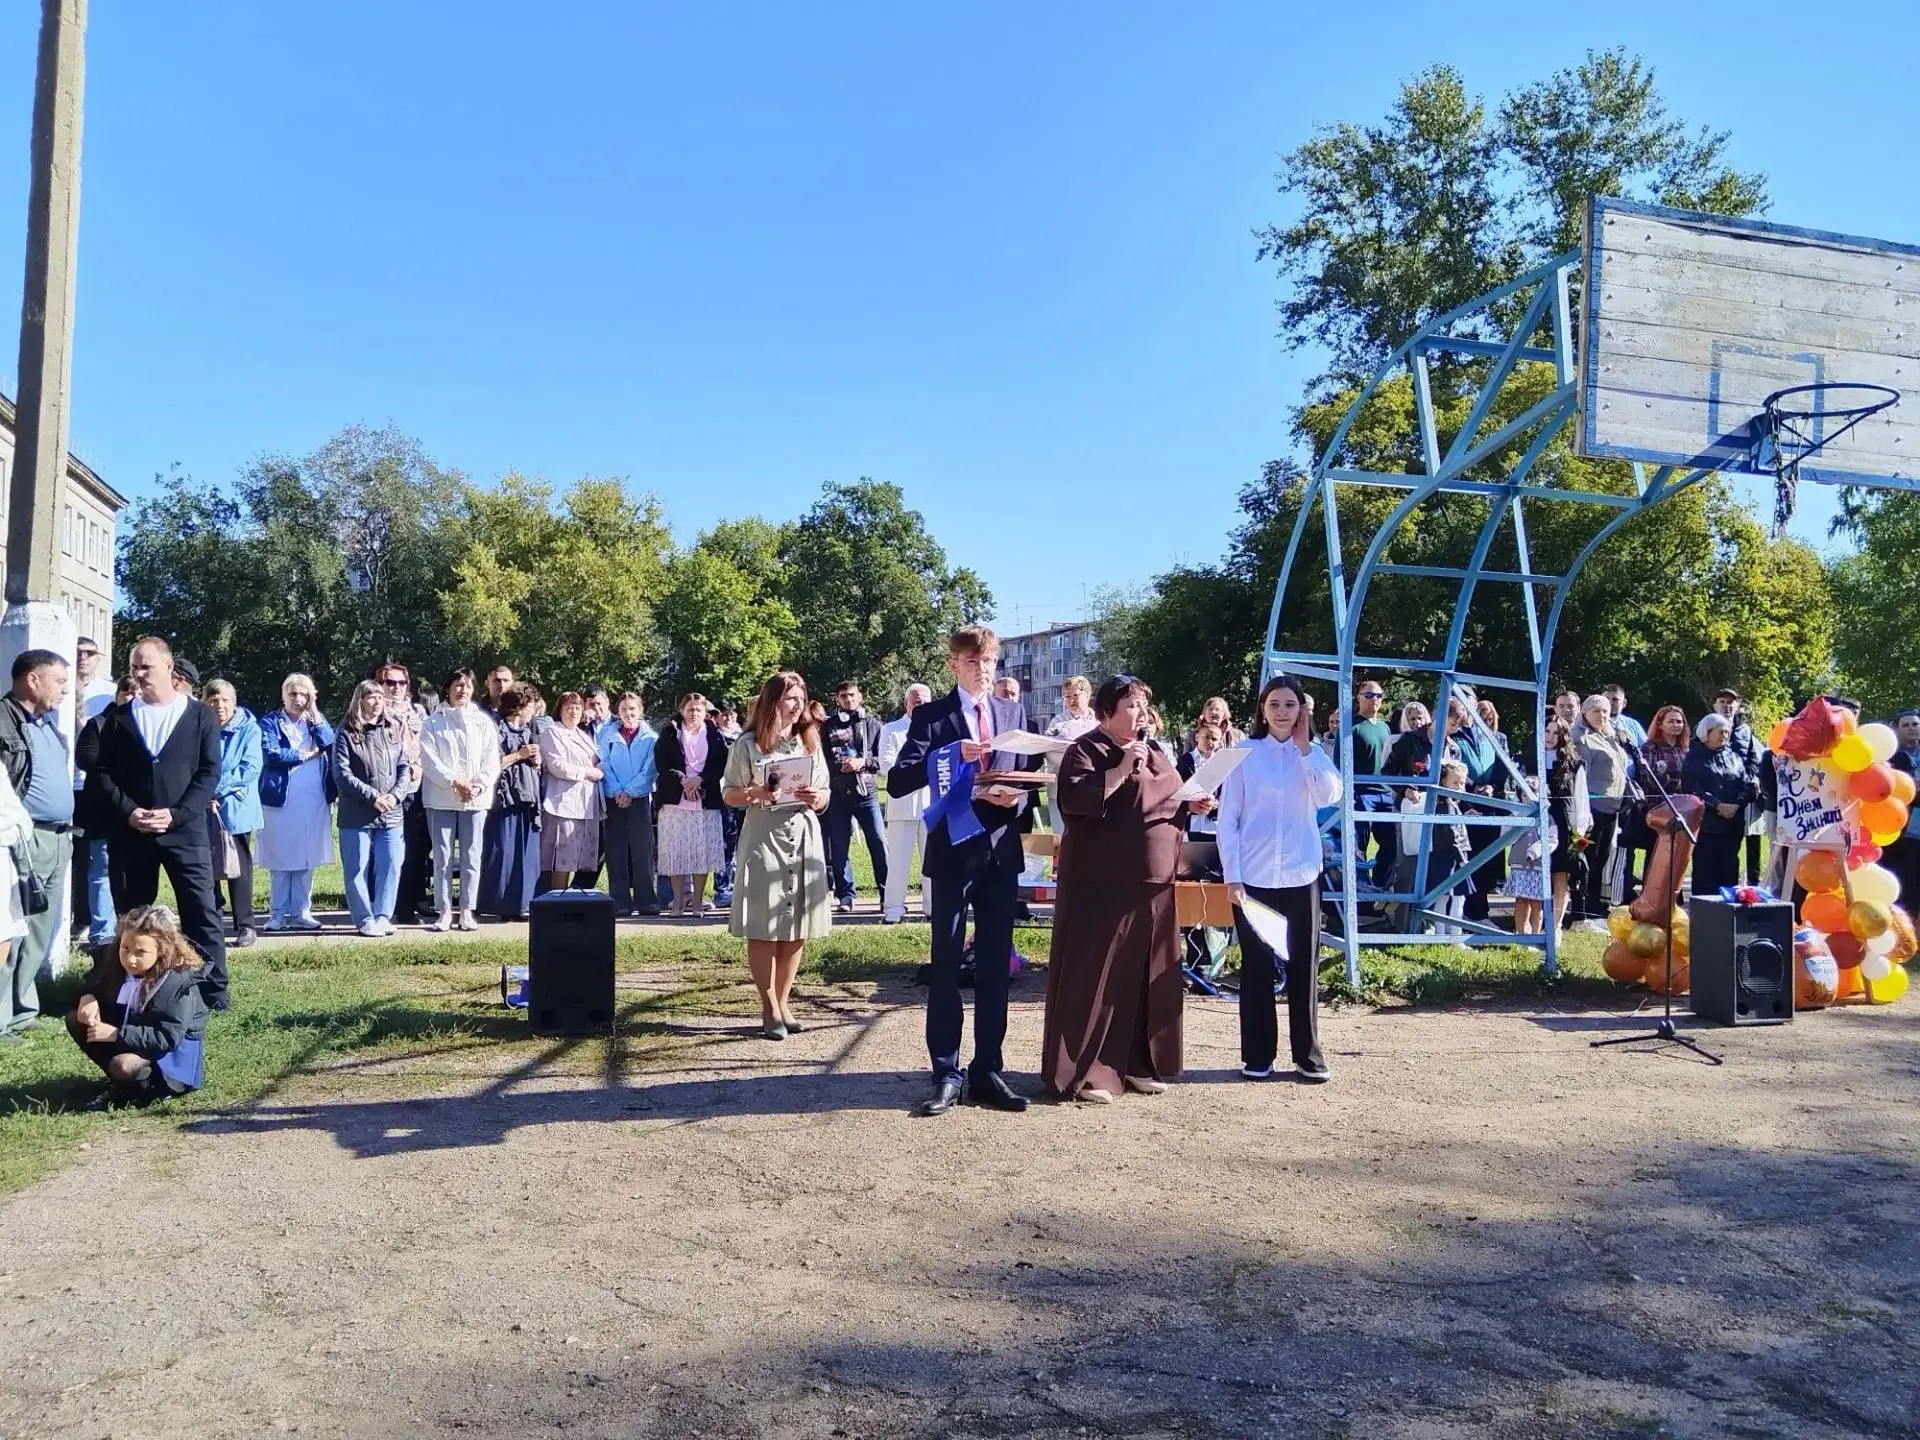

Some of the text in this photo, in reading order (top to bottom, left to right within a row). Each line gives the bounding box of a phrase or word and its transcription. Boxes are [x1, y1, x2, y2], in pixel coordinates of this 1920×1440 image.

[937, 757, 951, 798] ЕНИК
[1787, 769, 1805, 797] С
[1778, 796, 1823, 819] Днём
